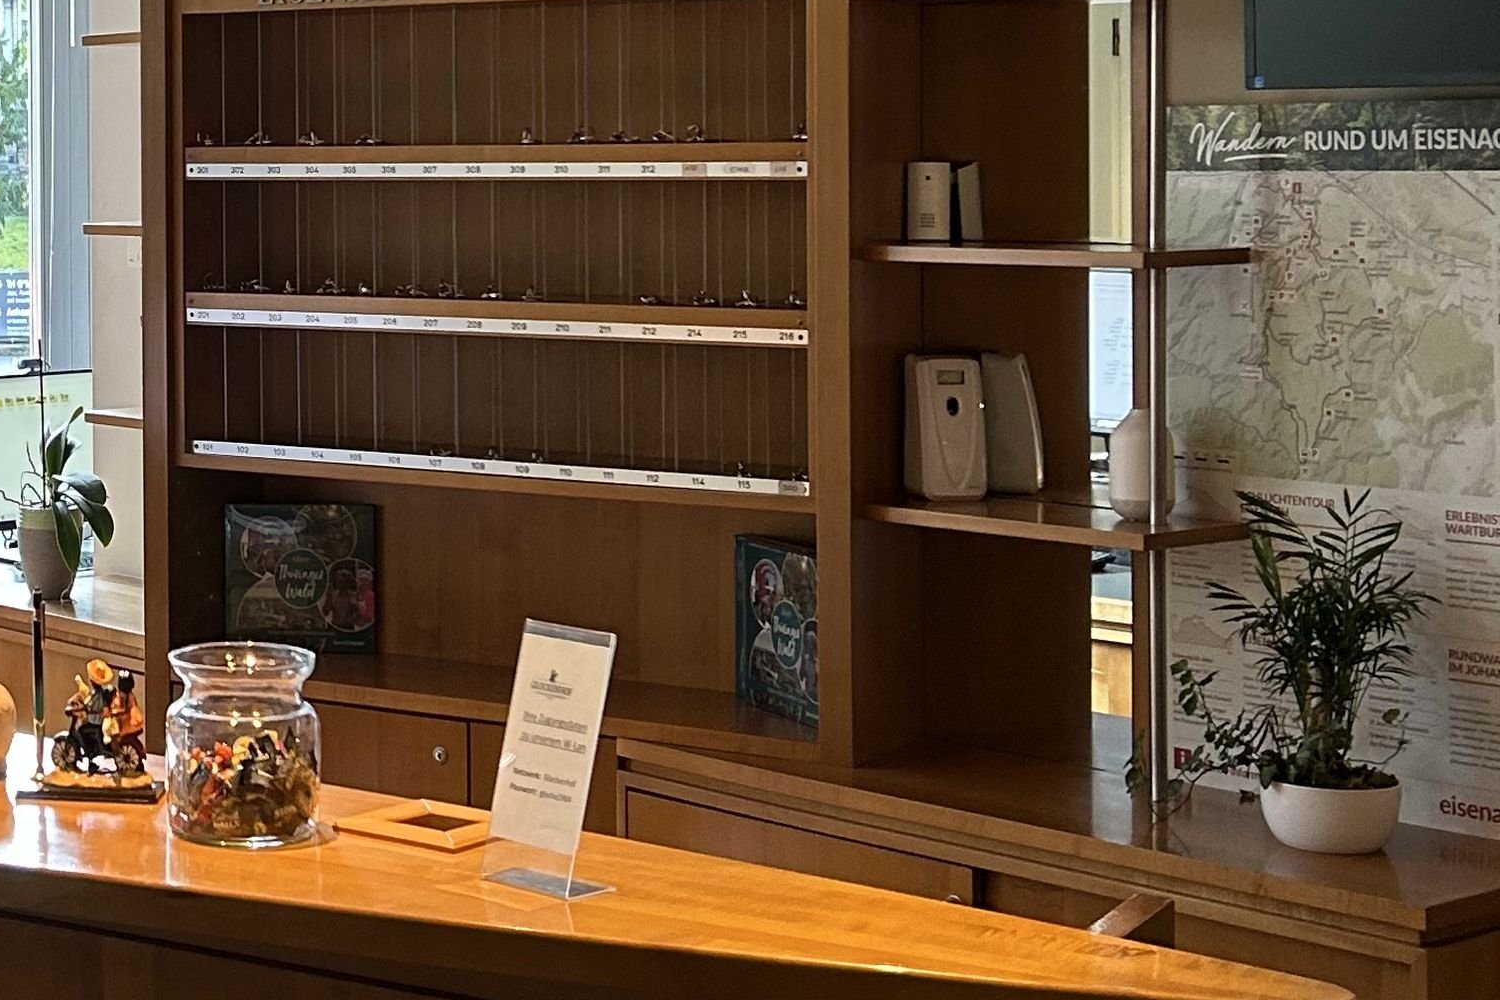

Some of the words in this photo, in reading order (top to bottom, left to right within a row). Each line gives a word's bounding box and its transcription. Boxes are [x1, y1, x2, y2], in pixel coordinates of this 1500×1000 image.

[1189, 112, 1298, 167] Wandern
[1304, 130, 1366, 150] RUND
[1371, 129, 1408, 150] UM
[1247, 490, 1336, 508] LUCHTENTOUR
[1445, 510, 1500, 525] ERLEBNIS
[1465, 664, 1500, 678] JOHA
[1439, 795, 1500, 824] eisena
